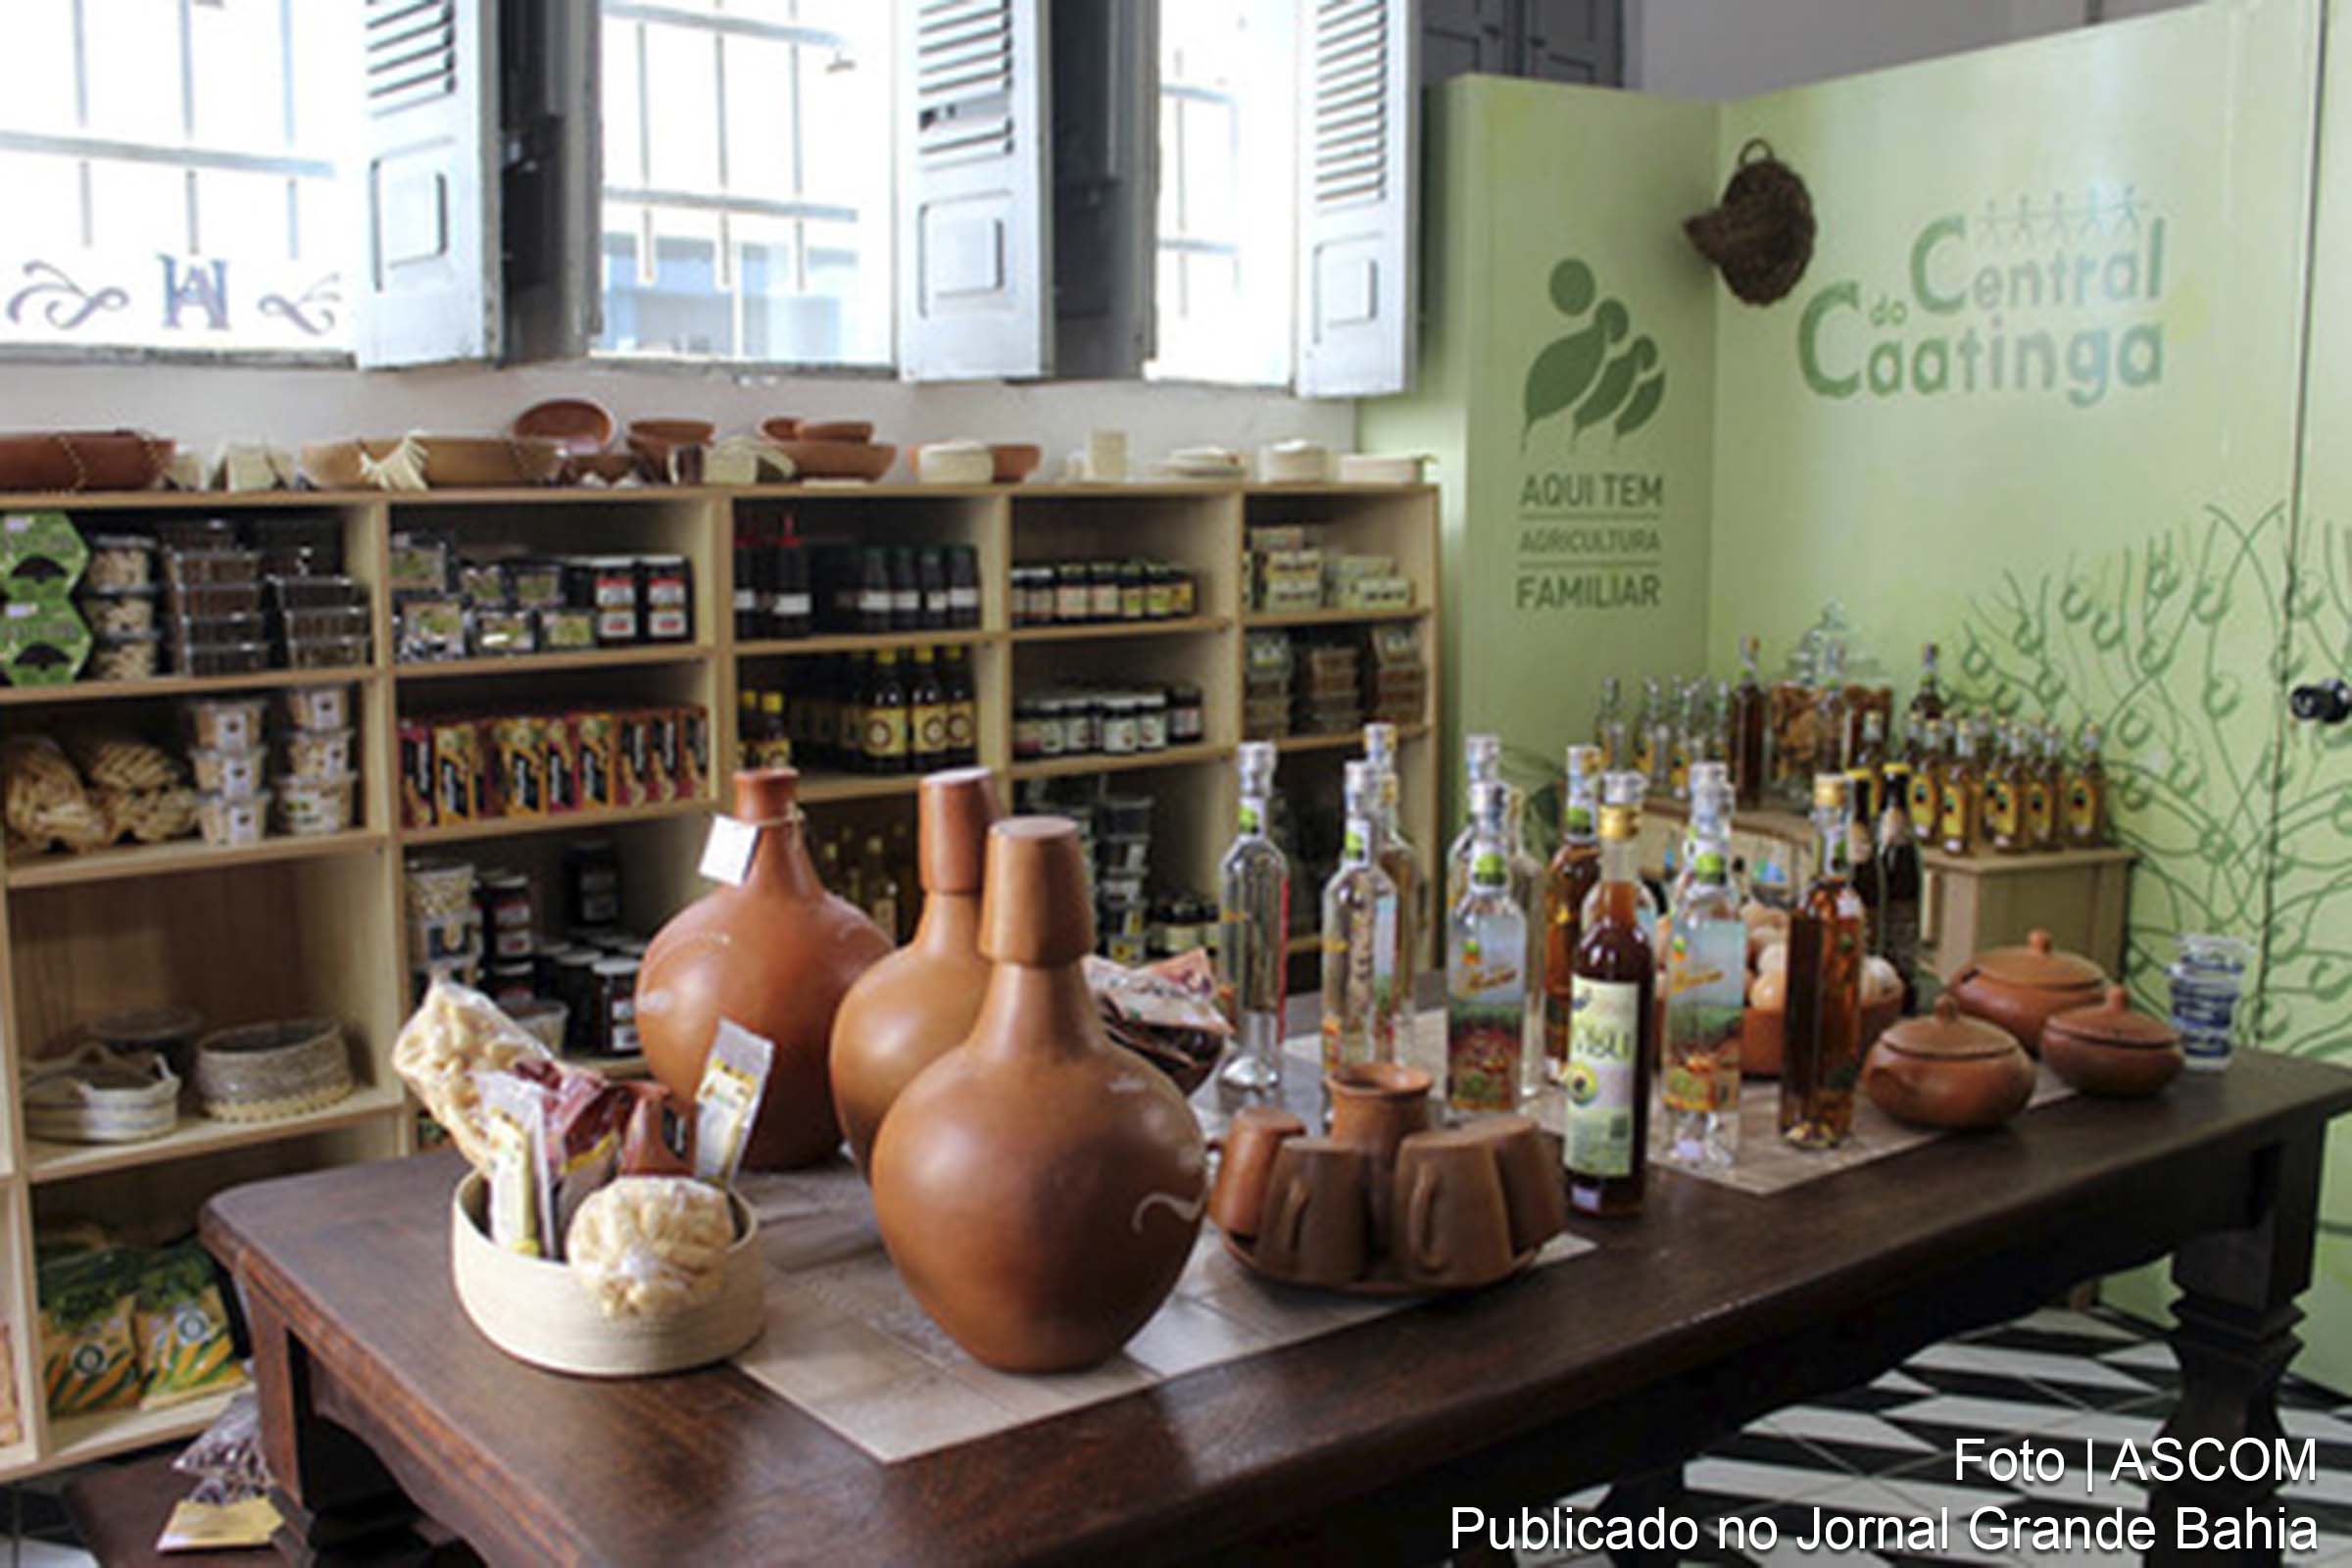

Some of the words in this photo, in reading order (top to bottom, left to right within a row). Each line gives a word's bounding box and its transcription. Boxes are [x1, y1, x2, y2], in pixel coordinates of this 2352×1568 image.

[1910, 216, 2167, 316] Central
[1798, 280, 2165, 408] Caatinga
[1520, 472, 1593, 507] AQUI
[1601, 472, 1662, 507] TEM
[1520, 528, 1661, 553] AGRICULTURA
[1517, 573, 1661, 609] FAMILIAR
